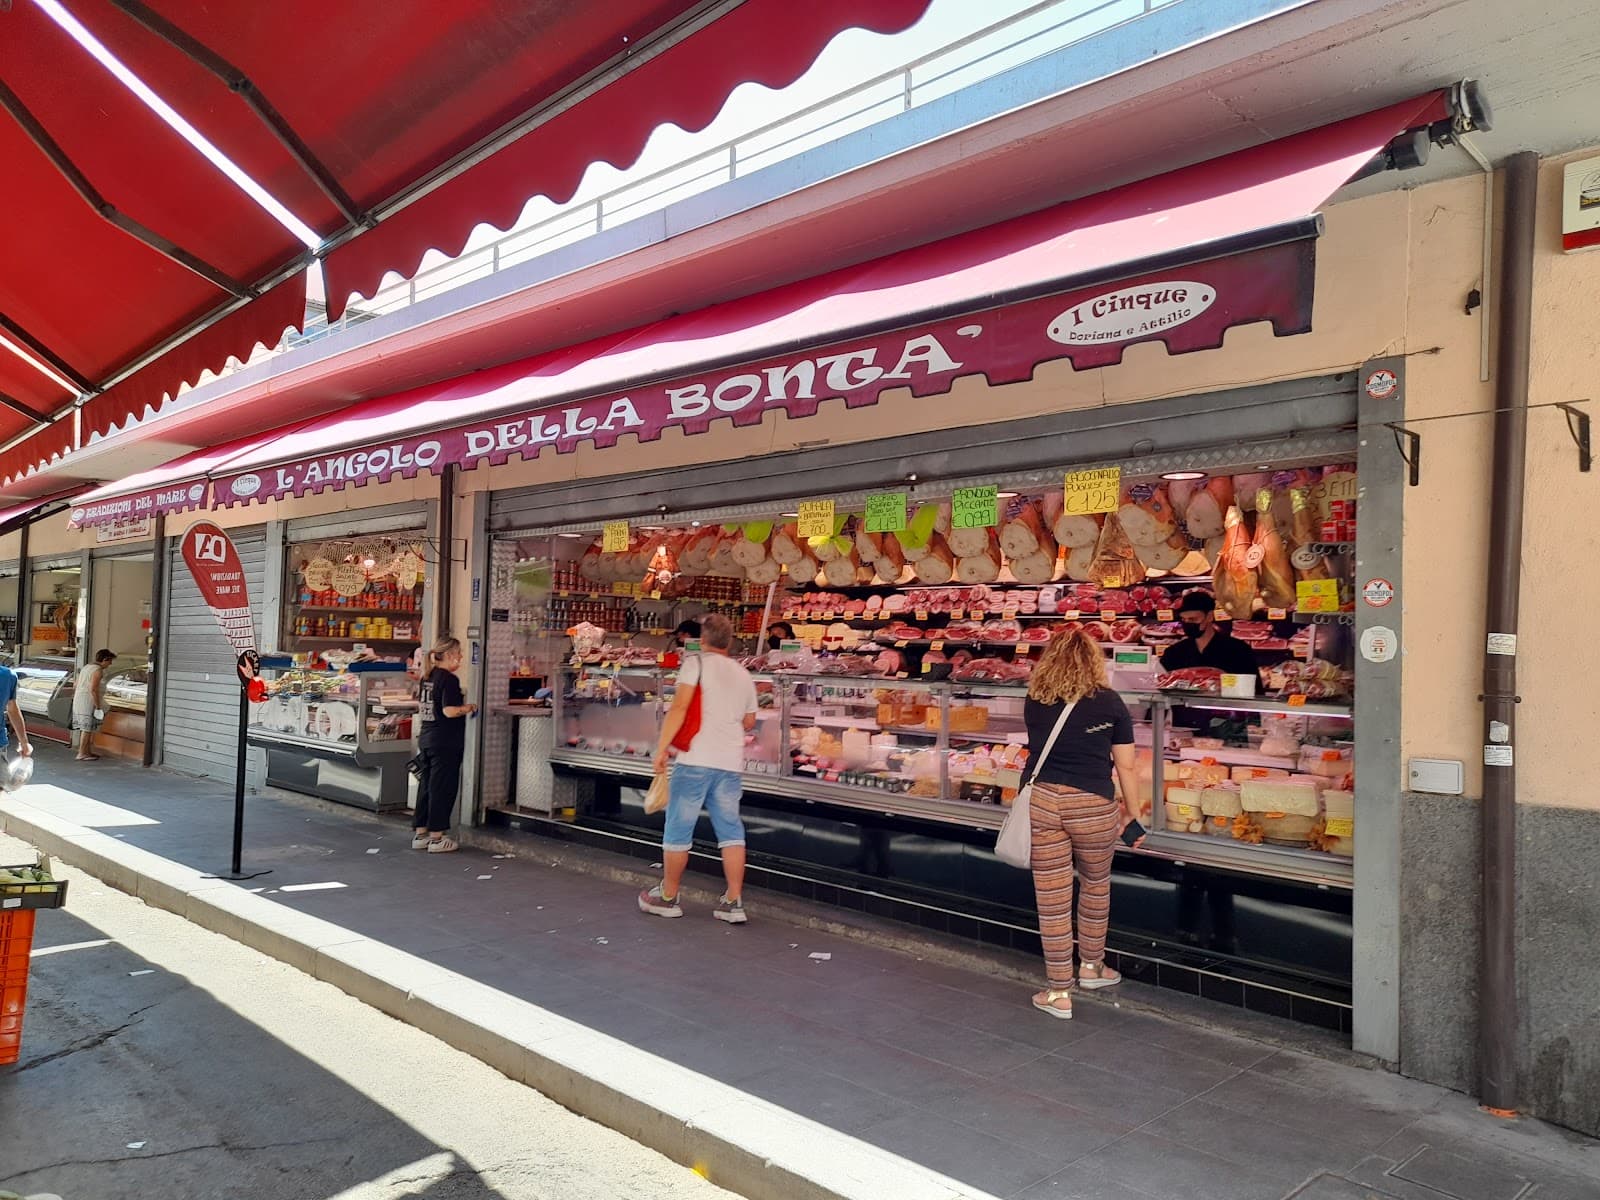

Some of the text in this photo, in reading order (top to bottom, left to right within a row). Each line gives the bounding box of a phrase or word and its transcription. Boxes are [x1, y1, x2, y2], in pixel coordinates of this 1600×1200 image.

[1069, 308, 1192, 341] Doriana e Attilio
[1072, 288, 1188, 327] I Cinque
[276, 441, 441, 490] L'ANGOLO
[464, 397, 645, 458] DELLA
[86, 500, 131, 518] TRADIZIONI
[135, 495, 152, 510] DEL
[156, 489, 186, 506] MARE
